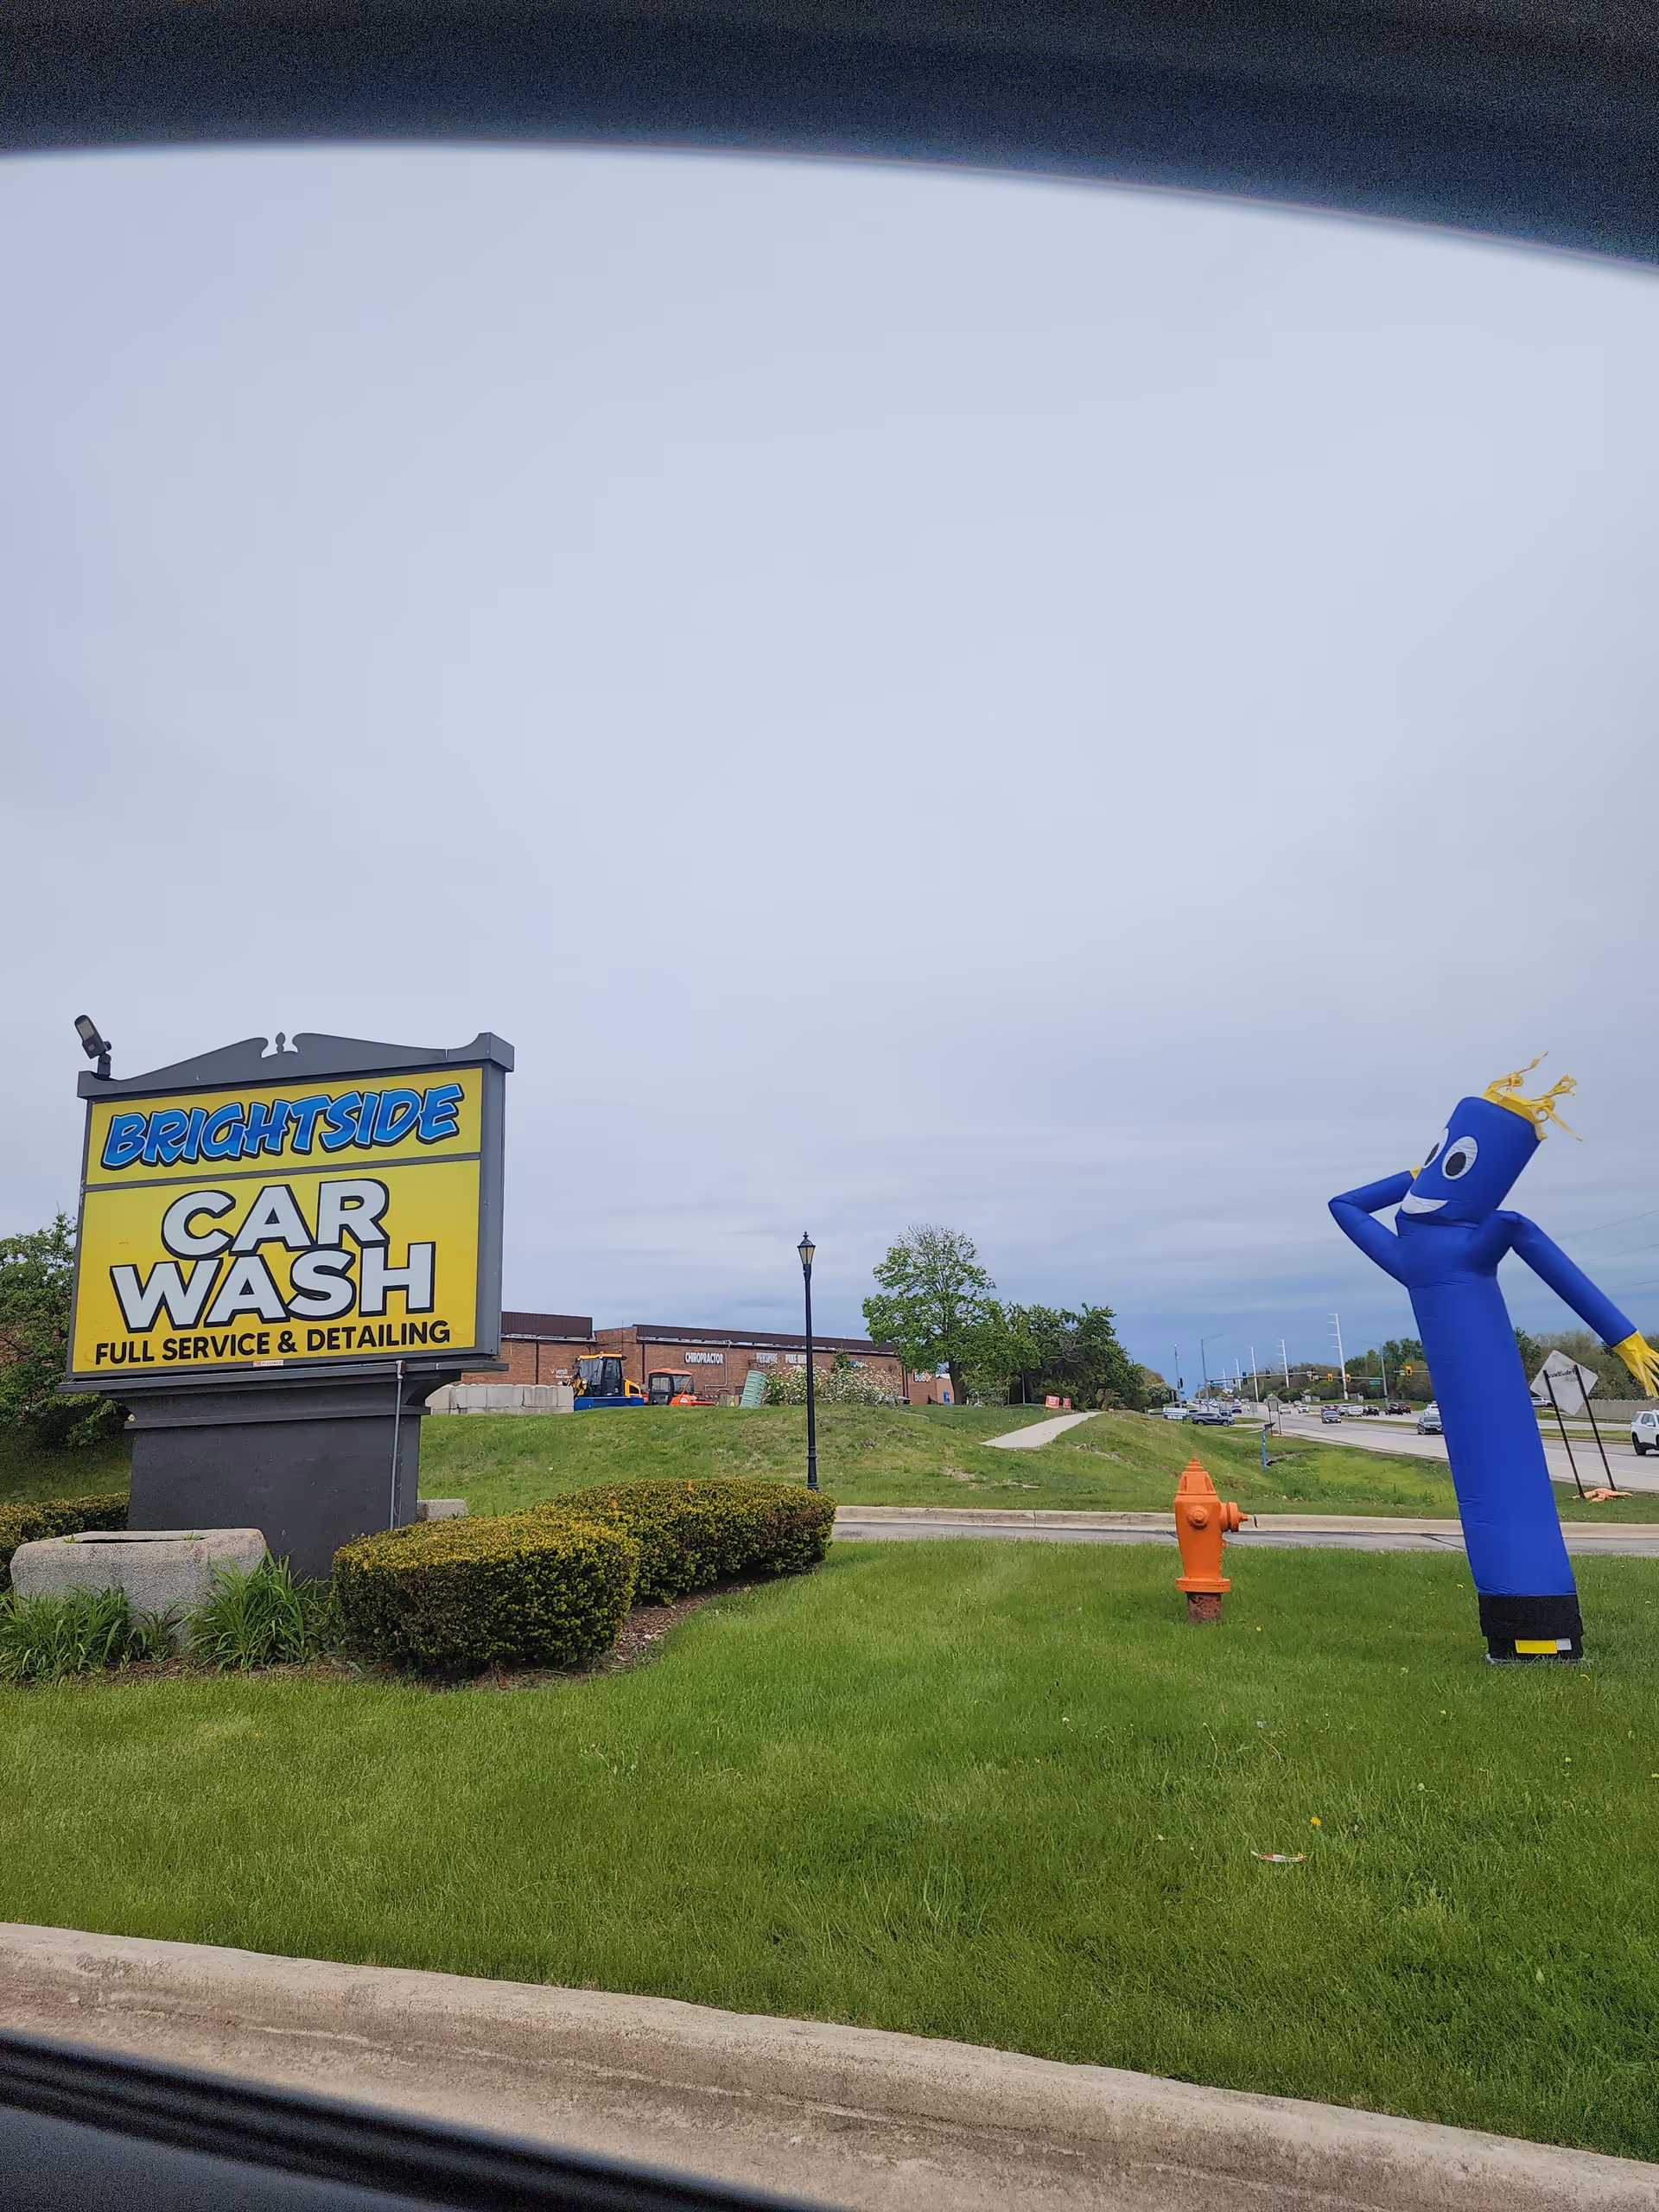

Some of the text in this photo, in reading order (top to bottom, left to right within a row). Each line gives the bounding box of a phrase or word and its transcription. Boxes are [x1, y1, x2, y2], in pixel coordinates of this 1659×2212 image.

[100, 1083, 464, 1170] BRIGHTSIDE
[161, 1179, 390, 1260] CAR
[110, 1242, 436, 1333] WASH
[95, 1320, 450, 1365] FULL SERVICE & DETAILING
[684, 1351, 724, 1364] CHIROPRACTOR
